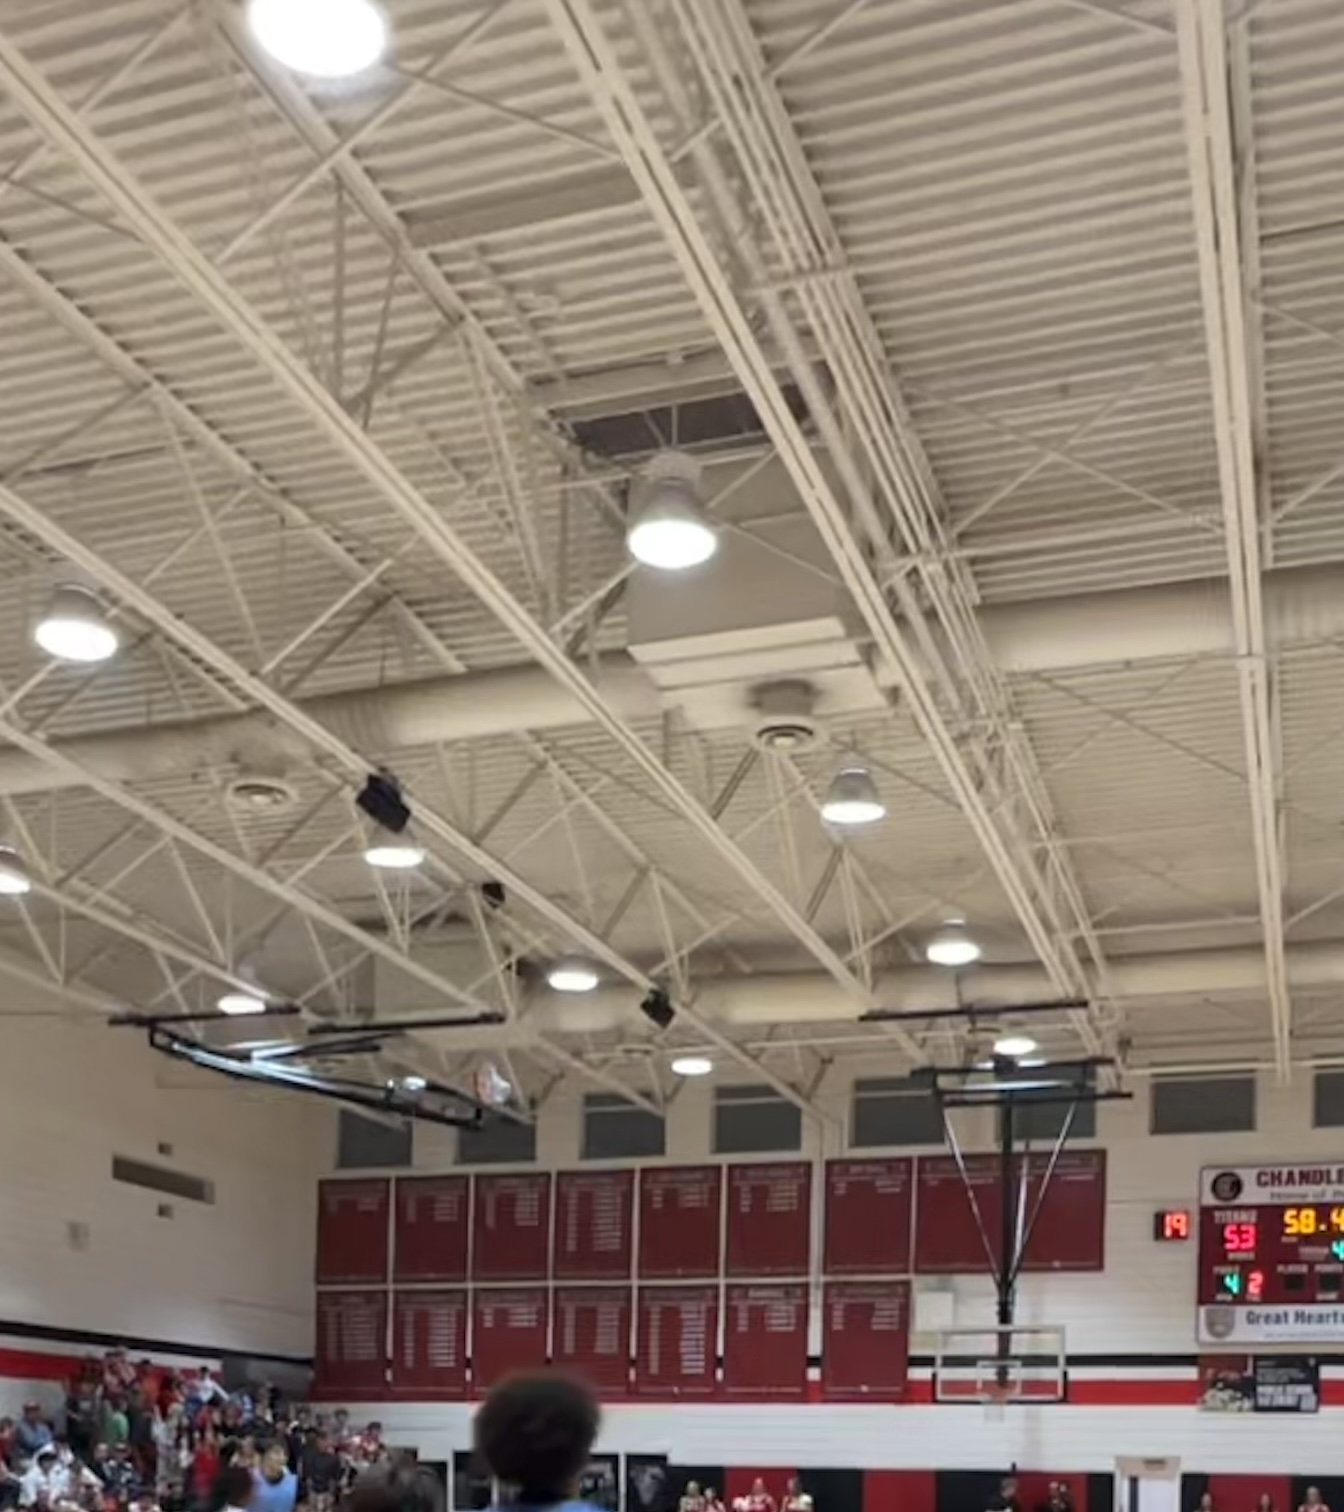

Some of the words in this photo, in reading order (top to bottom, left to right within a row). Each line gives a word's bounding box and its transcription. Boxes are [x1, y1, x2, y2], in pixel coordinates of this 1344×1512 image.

[1163, 1212, 1188, 1239] 19
[1223, 1223, 1256, 1250] 53
[1223, 1273, 1240, 1295] 4
[1248, 1271, 1264, 1294] 2
[1245, 1310, 1289, 1325] Great
